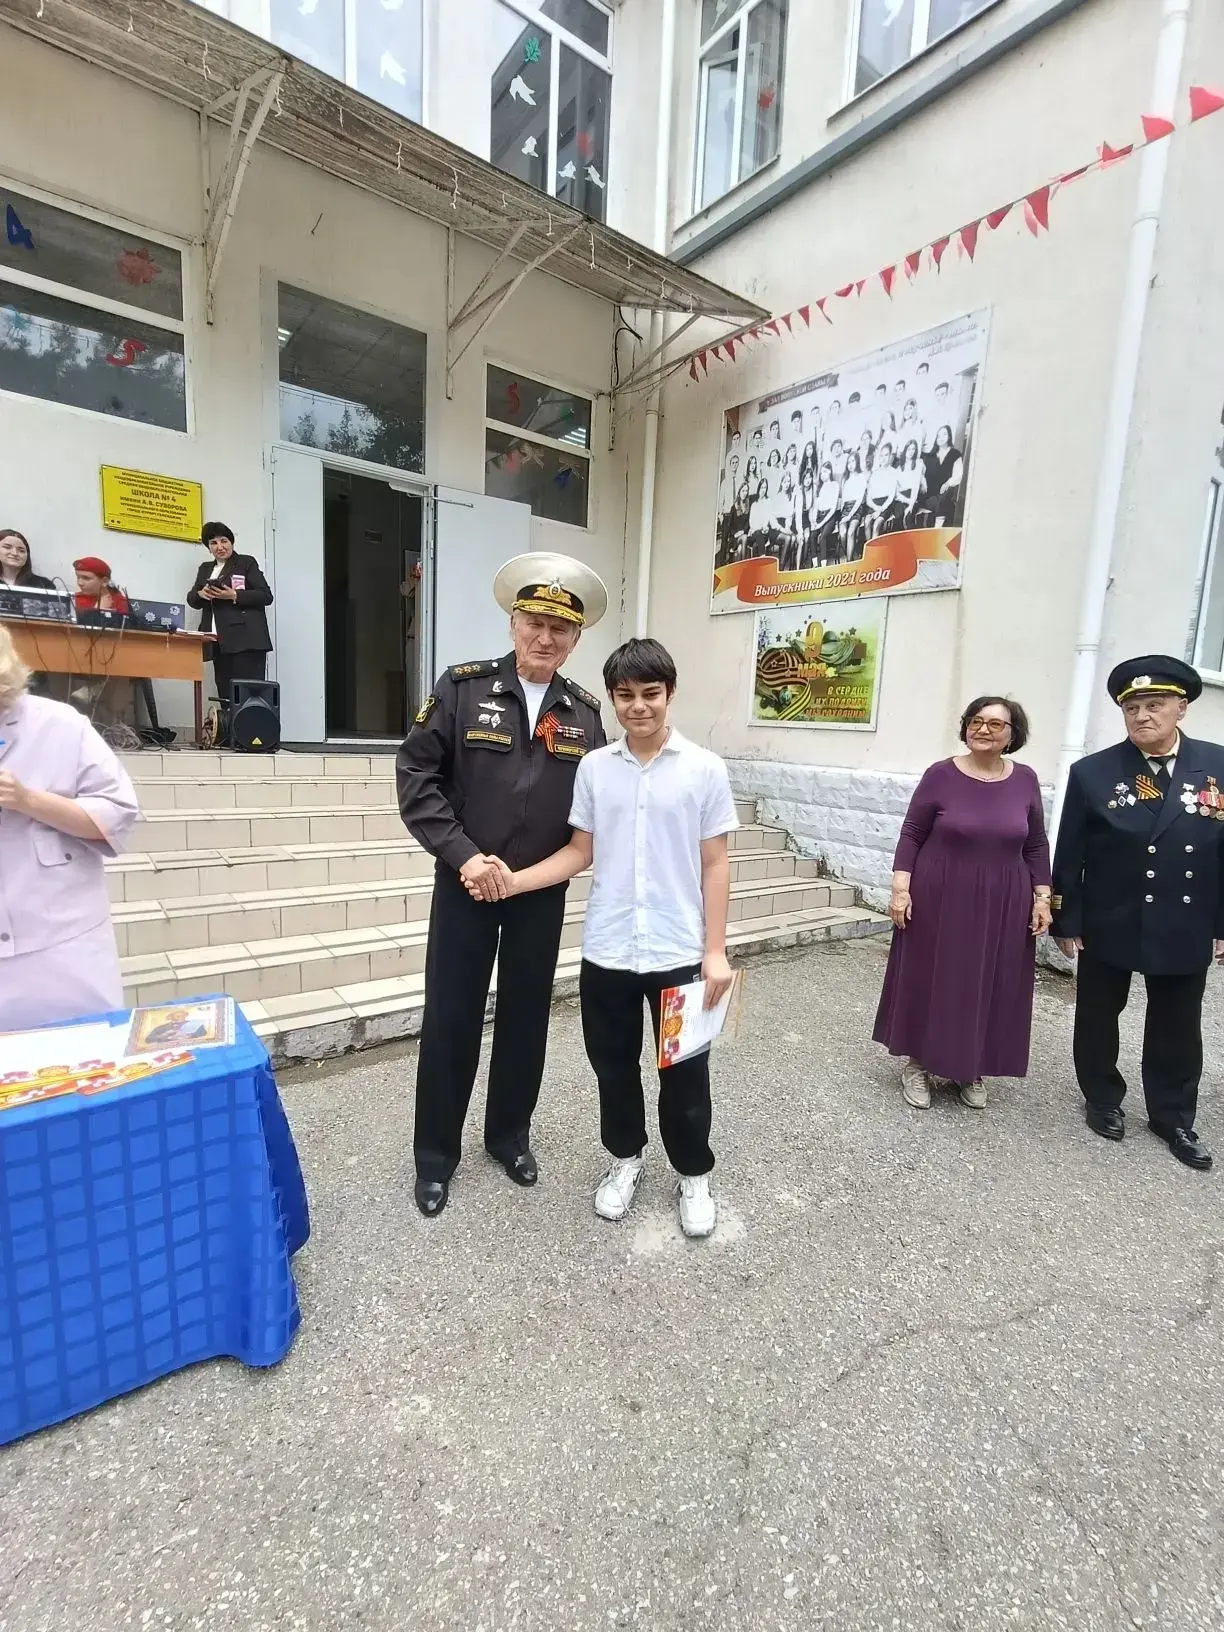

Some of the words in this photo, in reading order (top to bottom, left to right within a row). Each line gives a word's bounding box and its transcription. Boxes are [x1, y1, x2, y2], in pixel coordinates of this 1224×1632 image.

[131, 489, 160, 500] ШКОЛА
[155, 501, 187, 512] СУВОРОВА
[754, 579, 824, 599] Выпускники
[825, 572, 855, 589] 2021
[858, 568, 891, 583] года
[835, 685, 869, 695] СЕРДЦЕ
